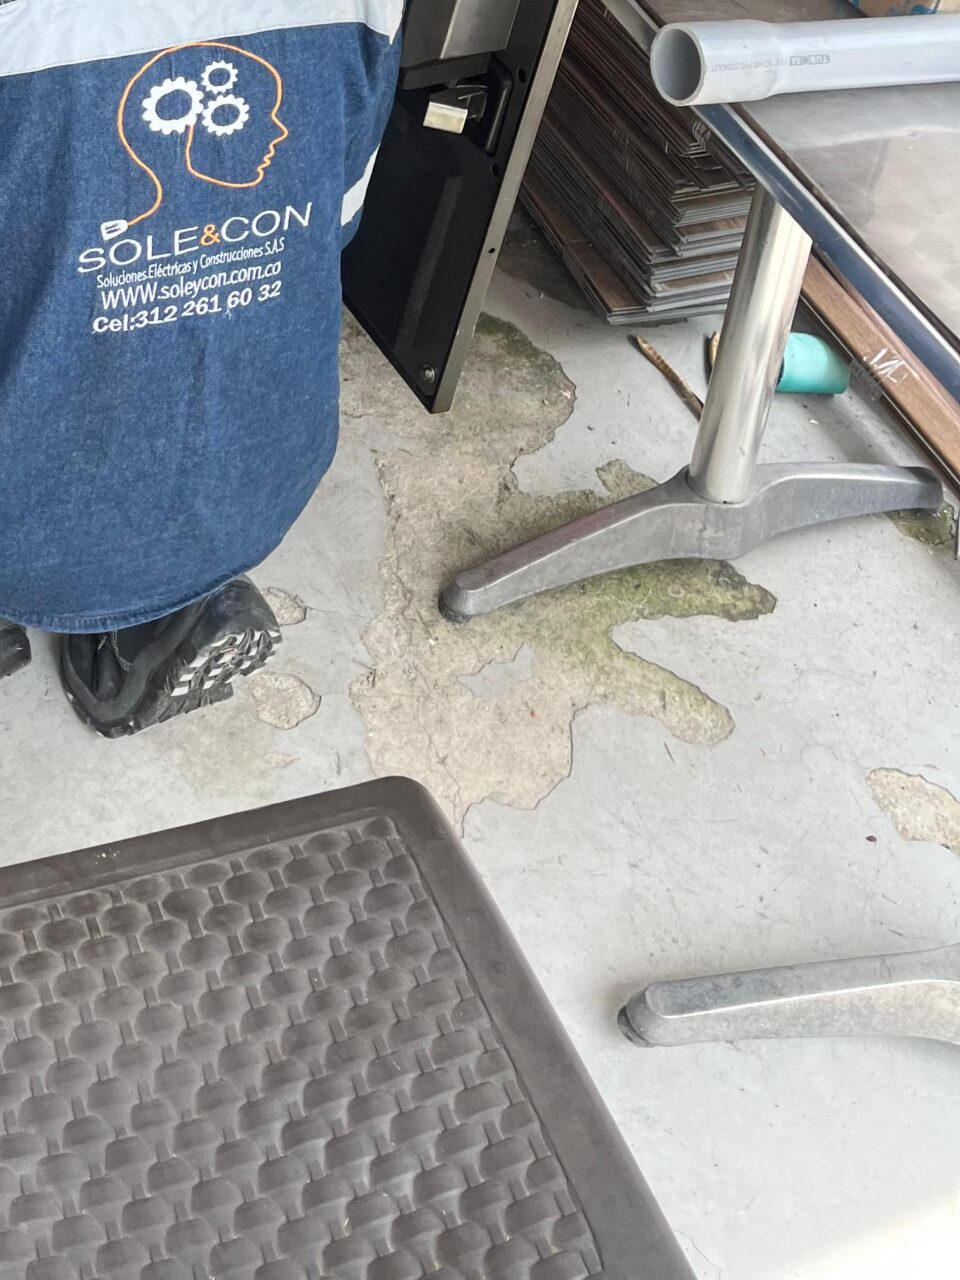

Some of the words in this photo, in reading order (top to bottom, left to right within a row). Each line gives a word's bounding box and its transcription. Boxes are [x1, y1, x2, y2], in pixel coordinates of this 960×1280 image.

[77, 201, 313, 273] SOLE&CON
[149, 261, 191, 279] Eléctricas
[192, 259, 199, 274] y
[200, 245, 263, 269] Construcciones
[101, 261, 282, 310] WWW.soleycon.com.co
[181, 295, 222, 317] 261
[227, 287, 252, 308] 60
[257, 280, 282, 301] 32
